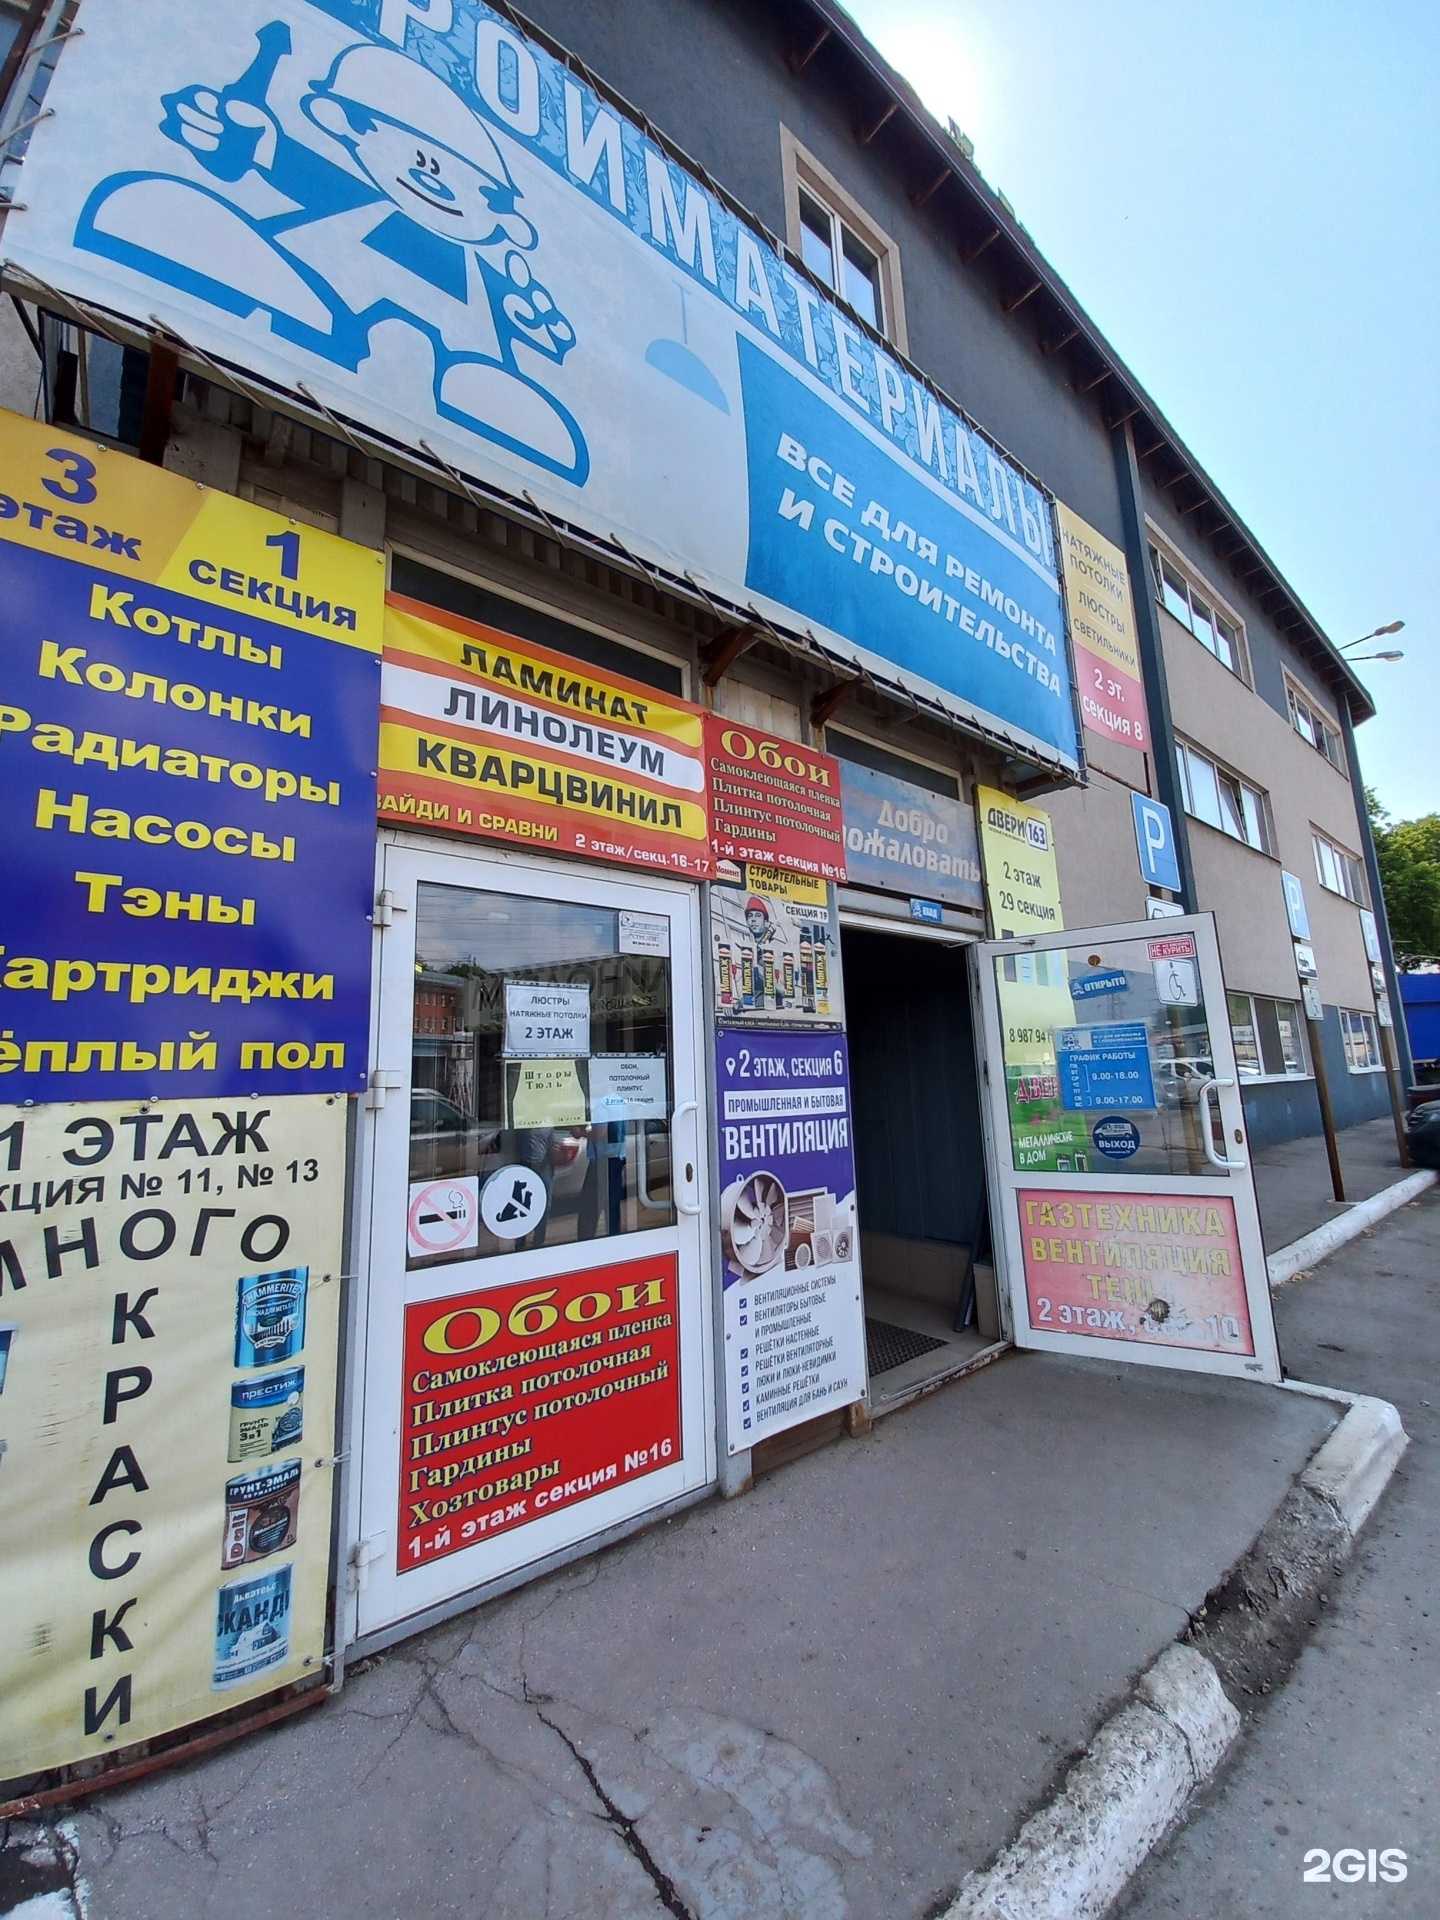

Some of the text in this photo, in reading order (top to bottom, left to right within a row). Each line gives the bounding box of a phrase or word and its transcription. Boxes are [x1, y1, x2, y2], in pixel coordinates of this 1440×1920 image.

[41, 447, 98, 505] 3
[265, 530, 301, 580] 1
[776, 432, 1057, 656] ВСЕ ДЛЯ РЕМОНТА
[1062, 529, 1125, 586] НАТЯЖНЫЕ
[188, 558, 357, 631] СЕКЦИЯ
[777, 487, 1060, 697] И СТРОИТЕЛЬСТВА
[1070, 554, 1123, 601] ПОТОЛКИ
[90, 584, 283, 670] Котлы
[1079, 591, 1125, 634] ЛЮСТРЫ
[1073, 617, 1135, 667] СВЕТИЛЬНИКИ
[38, 640, 312, 739] Колонки
[460, 643, 648, 725] ЛАМИНАТ
[1094, 668, 1103, 691] 2
[444, 686, 664, 777] ЛИНОЛЕУМ
[1134, 720, 1143, 741] 8
[0, 705, 341, 805] Радиаторы
[721, 730, 831, 788] Обои
[418, 737, 682, 829] КВАРЦВИНИЛ
[711, 757, 841, 808] Самоклеющаяся пленка
[712, 777, 831, 821] Плитка потолочная
[35, 788, 296, 862] Насосы
[377, 793, 559, 842] АЙДИ И СРАВНИ
[713, 797, 841, 843] Плинтус потолочный
[714, 818, 776, 842] Гардины
[878, 800, 949, 844] Добро
[988, 807, 1026, 838] ДВЕРИ
[1028, 823, 1046, 845] 163
[575, 833, 586, 849] 2
[711, 839, 847, 880] 1-й этаж секция №16
[750, 865, 819, 889] СТРОИТЕЛЬНЫЕ
[750, 878, 788, 894] ТОВАРЫ
[1003, 861, 1042, 888] 2 этаж
[75, 871, 256, 926] Тэны
[786, 905, 818, 918] СЕКЦИЯ
[999, 890, 1056, 921] 29 секция
[0, 945, 335, 1004] артриджи
[1084, 976, 1126, 992] ОТКРЫТО
[510, 1009, 588, 1020] НАТЯЖНЫЕ ПОТОЛКИ
[530, 996, 570, 1006] ЛЮСТРЫ
[240, 1039, 345, 1070] пол
[525, 1027, 574, 1040] 2 ЭТАЖ
[739, 1049, 843, 1079] 2 ЭТАЖ, СЕКЦИЯ 6
[1069, 1052, 1136, 1062] ГРАФИК РАБОТЫ
[728, 1093, 844, 1113] ПРОМЫШЛЕННАЯ И БЫТОВАЯ
[0, 1109, 271, 1171] 1 ЭТАЖ
[724, 1117, 849, 1160] ВЕНТИЛЯЦИЯ
[1027, 1150, 1047, 1165] ДОМ
[1098, 1139, 1136, 1150] ВЫХОД
[120, 1172, 163, 1201] №
[177, 1168, 224, 1196] 11,
[238, 1163, 274, 1189] №
[286, 1159, 320, 1184] 13
[1025, 1200, 1225, 1238] ГАЗТЕХНИКА
[1031, 1238, 1232, 1277] ВЕНТИЛЯЦИЯ
[246, 1282, 298, 1303] HAMMERITE
[754, 1274, 836, 1306] ВЕНТИЛЯЦИОННЫЕ СИСТЕМЫ
[754, 1292, 826, 1322] ВЕНТИЛЯТОРЫ БЫТОВЫЕ
[423, 1278, 666, 1355] Обои
[760, 1312, 812, 1336] ПРОМЫШЛЕННЫЕ
[785, 1325, 820, 1345] НАСТЕННЫЕ
[1037, 1297, 1052, 1322] 2
[1057, 1303, 1137, 1335] этаж,
[412, 1313, 673, 1394] Самоклеющаяся пленка
[786, 1336, 833, 1361] ВЕНТИЛЯТОРНЫЕ
[412, 1343, 651, 1428] Плитка потолочная
[756, 1383, 791, 1405] КАМИННЫЕ
[410, 1360, 669, 1460] Плинтус потолочный
[756, 1400, 798, 1422] ВЕНТИЛЯЦИЯ
[230, 1467, 299, 1496] ГРУНТ-ЭМАЛЬ
[410, 1437, 533, 1493] Гардины
[408, 1438, 673, 1559] 1-й этаж секция №16
[409, 1459, 561, 1529] Хозтовары
